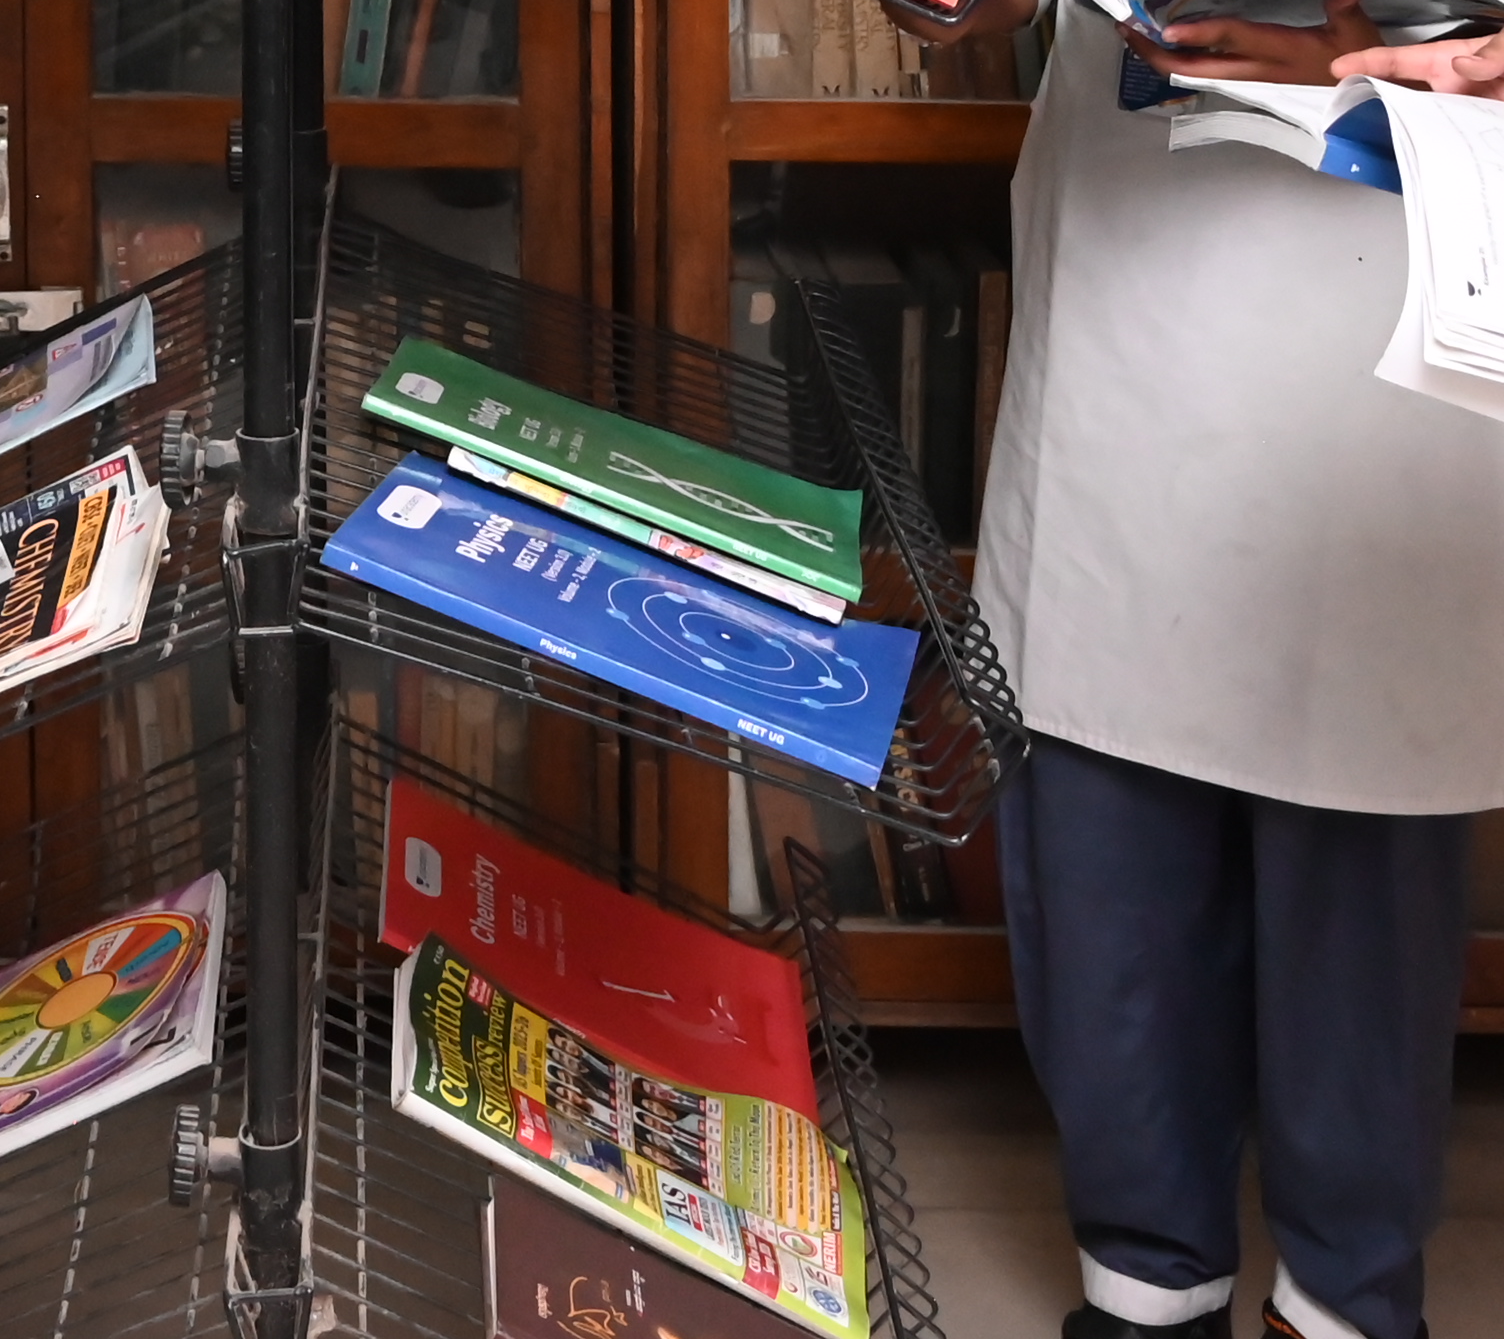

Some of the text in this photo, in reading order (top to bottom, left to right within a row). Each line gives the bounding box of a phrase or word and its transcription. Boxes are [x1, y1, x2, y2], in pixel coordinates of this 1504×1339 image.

[454, 514, 514, 563] Physics
[512, 548, 542, 572] NEET
[538, 637, 578, 662] Physics
[736, 717, 764, 739] NEET
[468, 853, 502, 946] Chemistry
[423, 958, 472, 1107] competition
[483, 989, 507, 1045] review
[660, 1182, 692, 1225] IAS
[821, 1231, 838, 1275] NERIM
